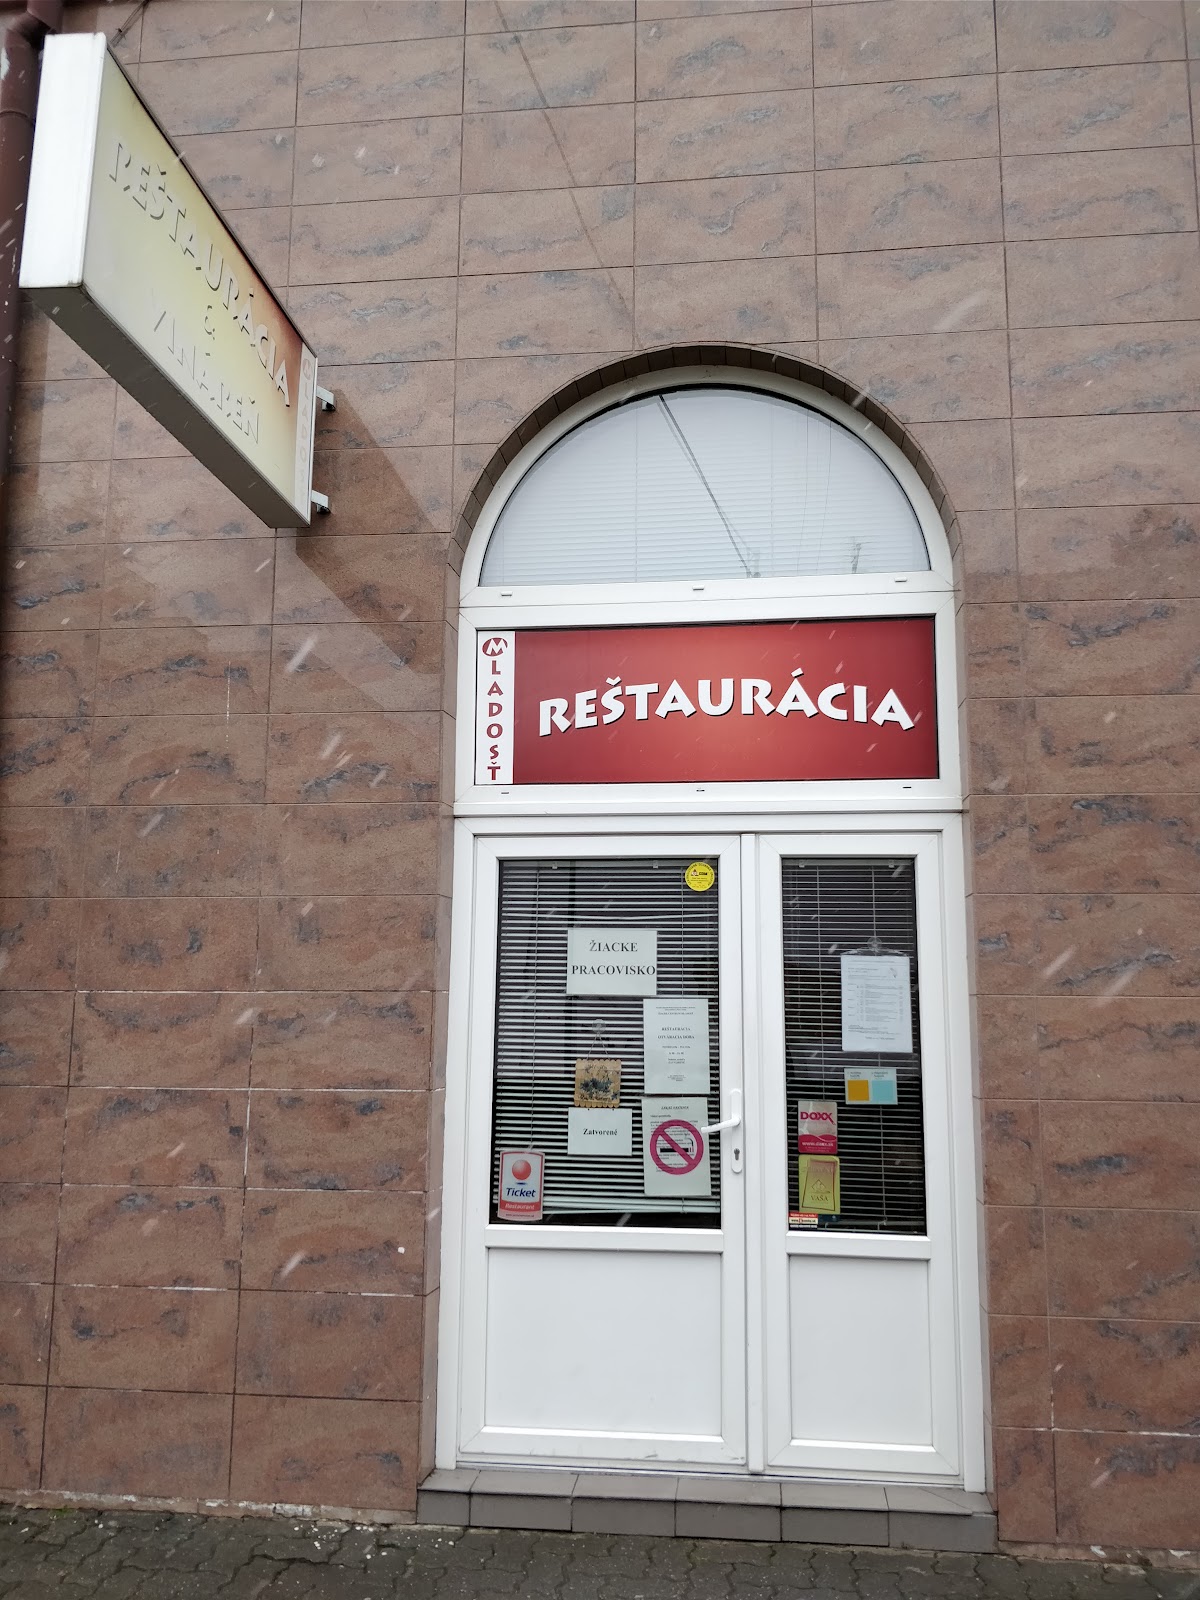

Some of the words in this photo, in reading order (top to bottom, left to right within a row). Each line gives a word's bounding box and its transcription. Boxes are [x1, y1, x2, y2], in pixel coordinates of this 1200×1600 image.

[538, 667, 916, 737] REŠTAURÁCIA
[481, 637, 509, 781] MLADOSŤ
[589, 940, 638, 952] ŽIACKE
[571, 964, 656, 976] PRACOVISKO
[582, 1127, 618, 1136] Zatvorené
[505, 1187, 537, 1198] Ticket
[504, 1203, 535, 1211] Restaurant
